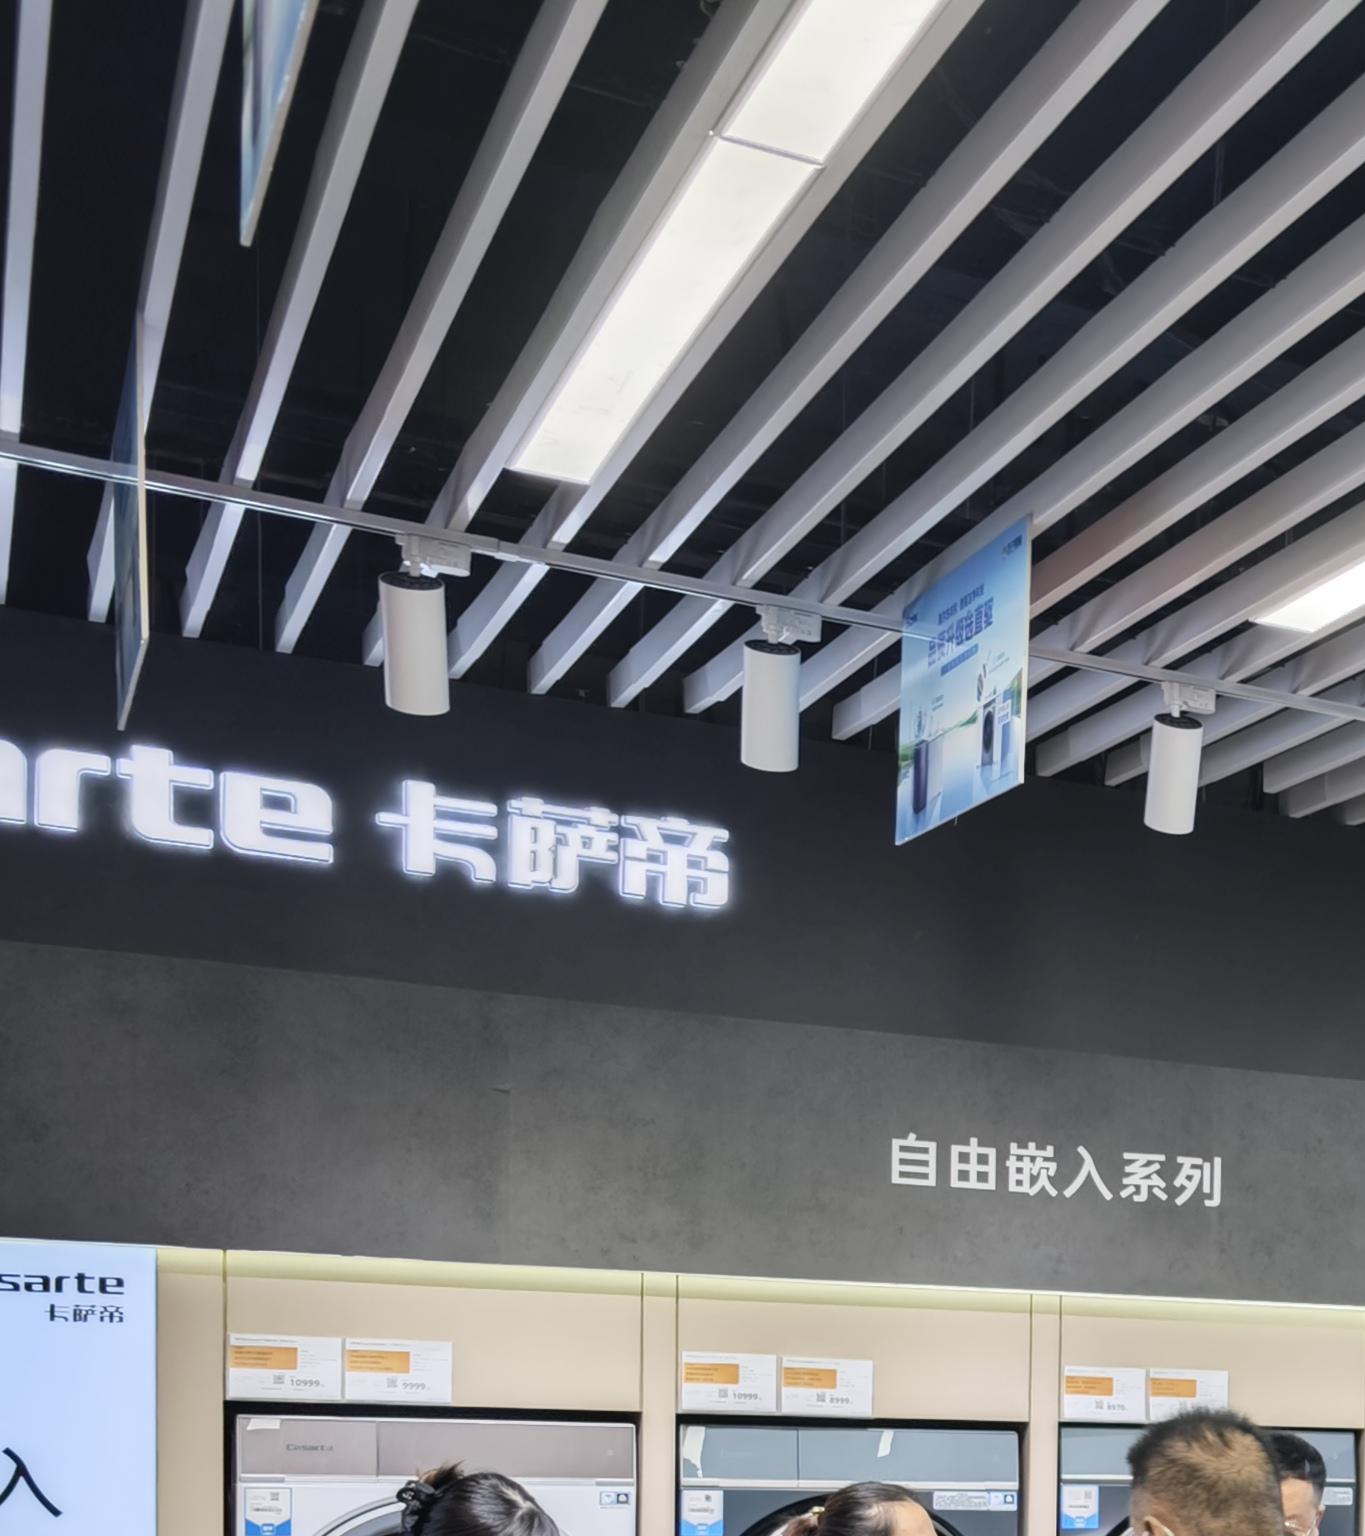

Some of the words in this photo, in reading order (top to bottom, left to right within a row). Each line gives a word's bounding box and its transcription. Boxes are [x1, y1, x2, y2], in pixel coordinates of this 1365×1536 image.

[376, 779, 730, 910] 卡萨帝
[890, 1131, 1223, 1208] 自由嵌入系列
[44, 1304, 125, 1325] 卡萨帝
